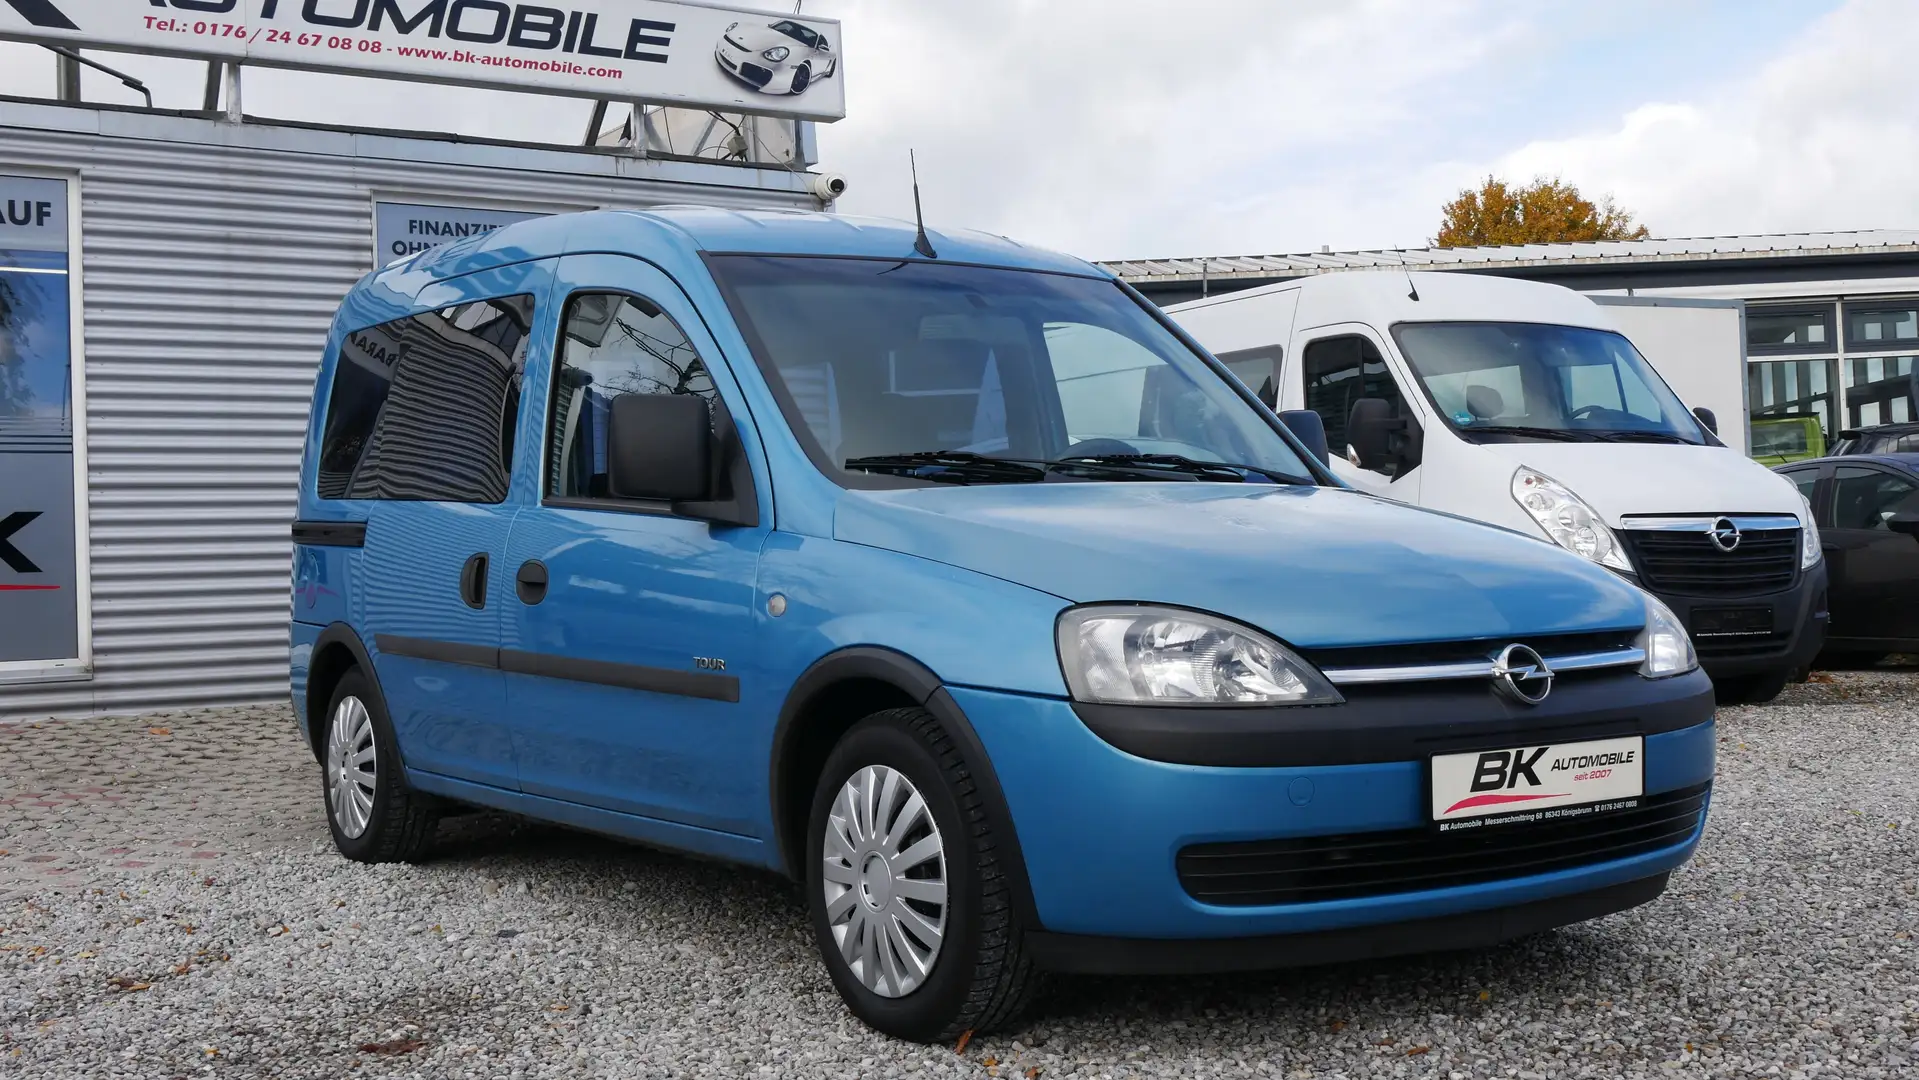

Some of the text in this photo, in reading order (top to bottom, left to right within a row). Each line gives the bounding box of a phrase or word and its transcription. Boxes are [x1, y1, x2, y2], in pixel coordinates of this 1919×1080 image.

[143, 16, 188, 33] Tel.:
[266, 29, 291, 43] 24
[297, 33, 322, 46] 67
[328, 36, 352, 51] 08
[357, 40, 382, 53] 08
[397, 46, 622, 79] www.bk-automobile.com
[0, 199, 52, 227] UF
[692, 656, 725, 671] TOUR
[1469, 746, 1635, 793] BK AUTOMOBILE
[1573, 769, 1613, 782] seit 2007
[1439, 822, 1450, 832] BK
[1450, 819, 1483, 830] Automobile
[1561, 807, 1592, 818] Königsbrunn
